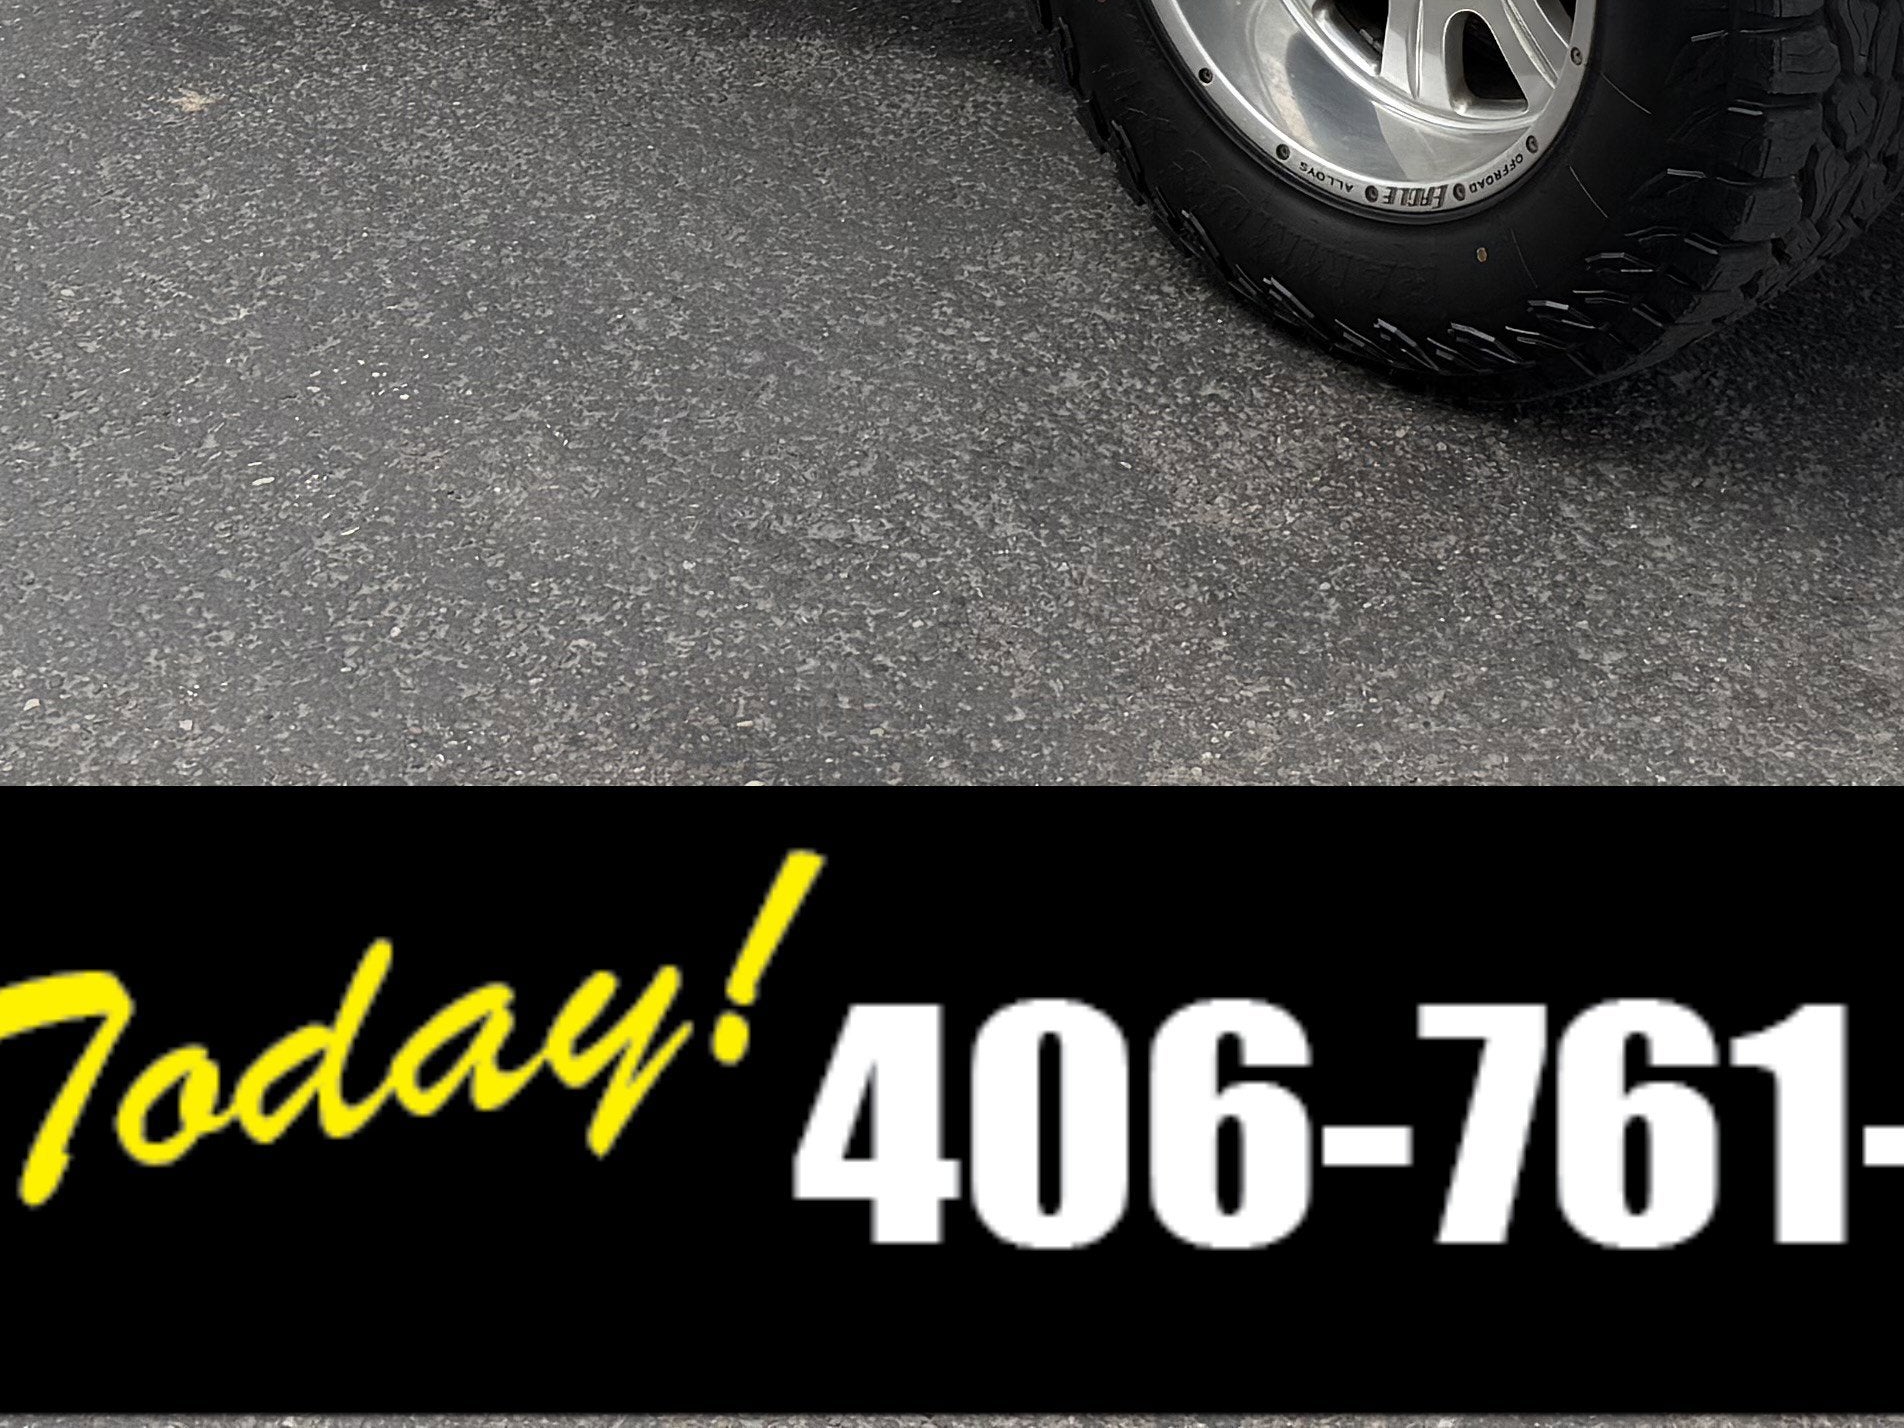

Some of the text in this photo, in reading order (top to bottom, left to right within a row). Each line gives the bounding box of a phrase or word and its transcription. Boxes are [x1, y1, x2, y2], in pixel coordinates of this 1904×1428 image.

[1299, 153, 1524, 209] OFFROAD EAGLE ALLOYS
